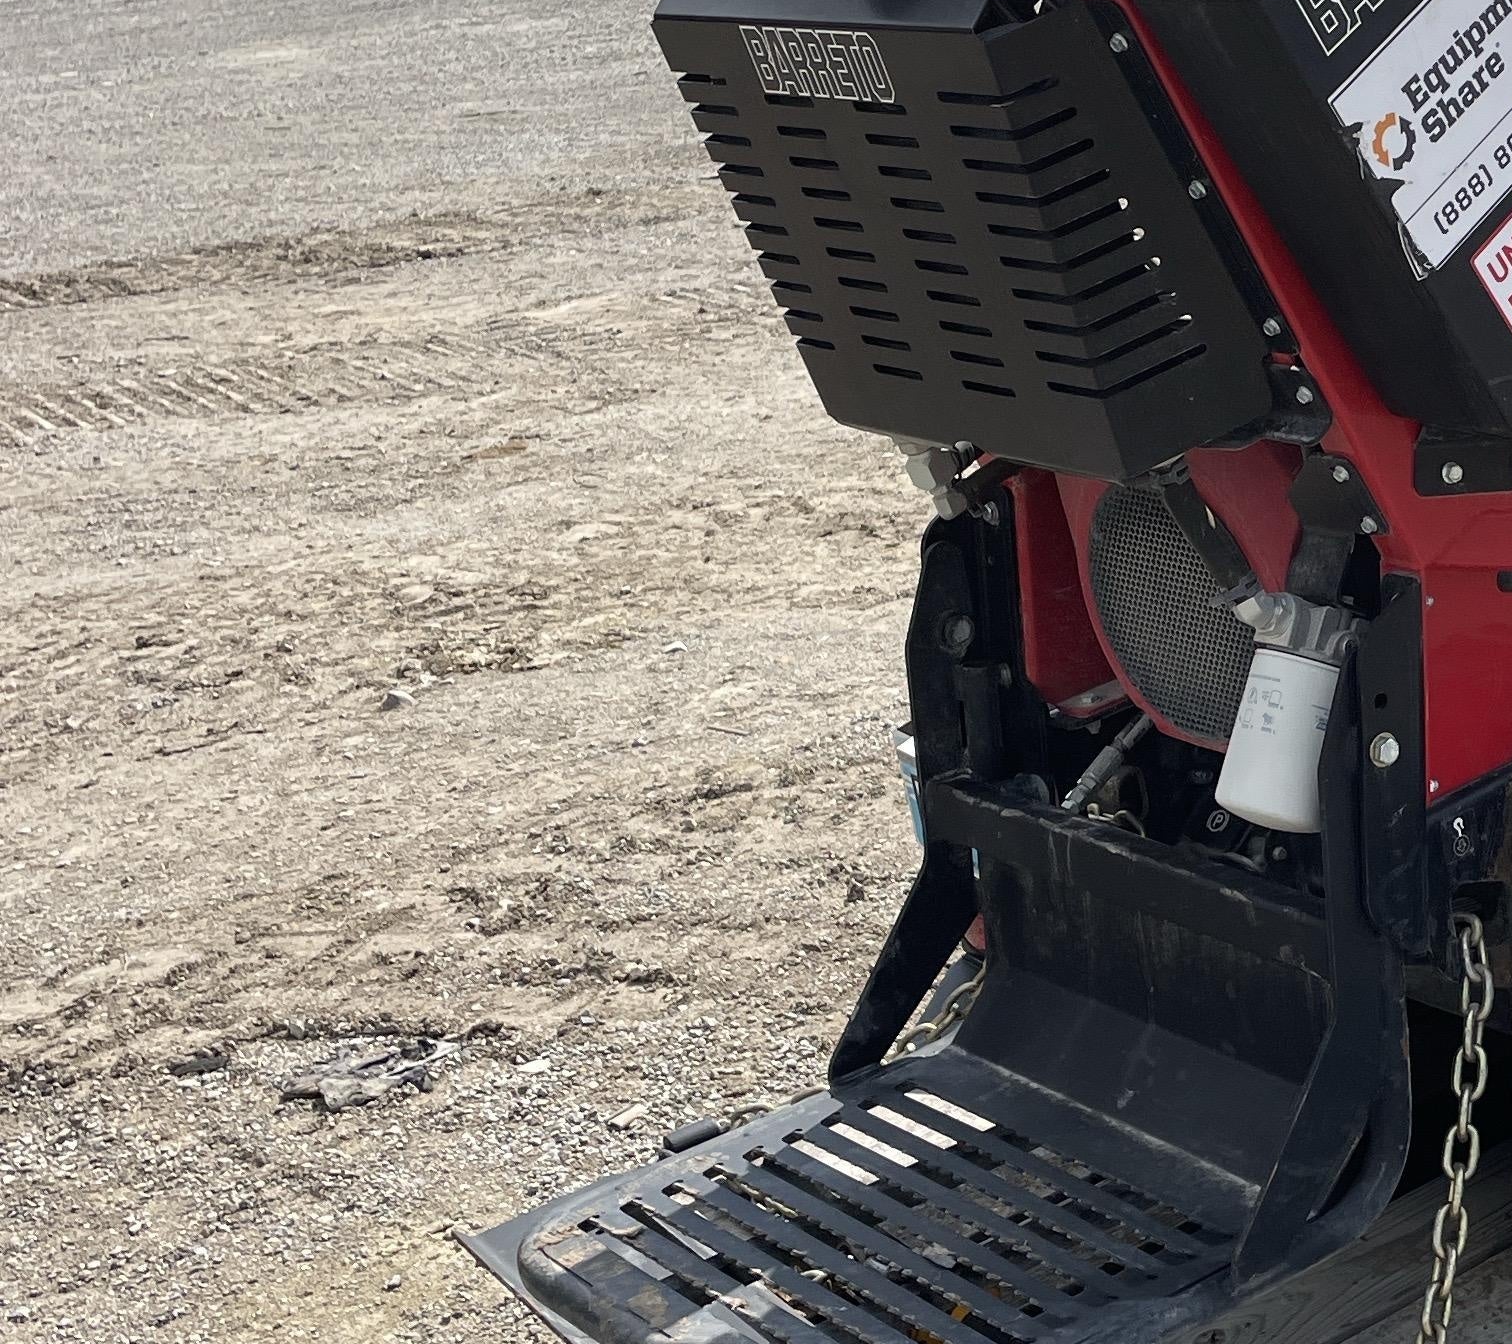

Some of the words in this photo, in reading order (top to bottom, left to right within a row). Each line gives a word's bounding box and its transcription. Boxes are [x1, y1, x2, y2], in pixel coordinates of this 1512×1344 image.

[738, 25, 896, 104] BARRETO
[1421, 52, 1506, 144] Share
[1433, 164, 1494, 236] (888)
